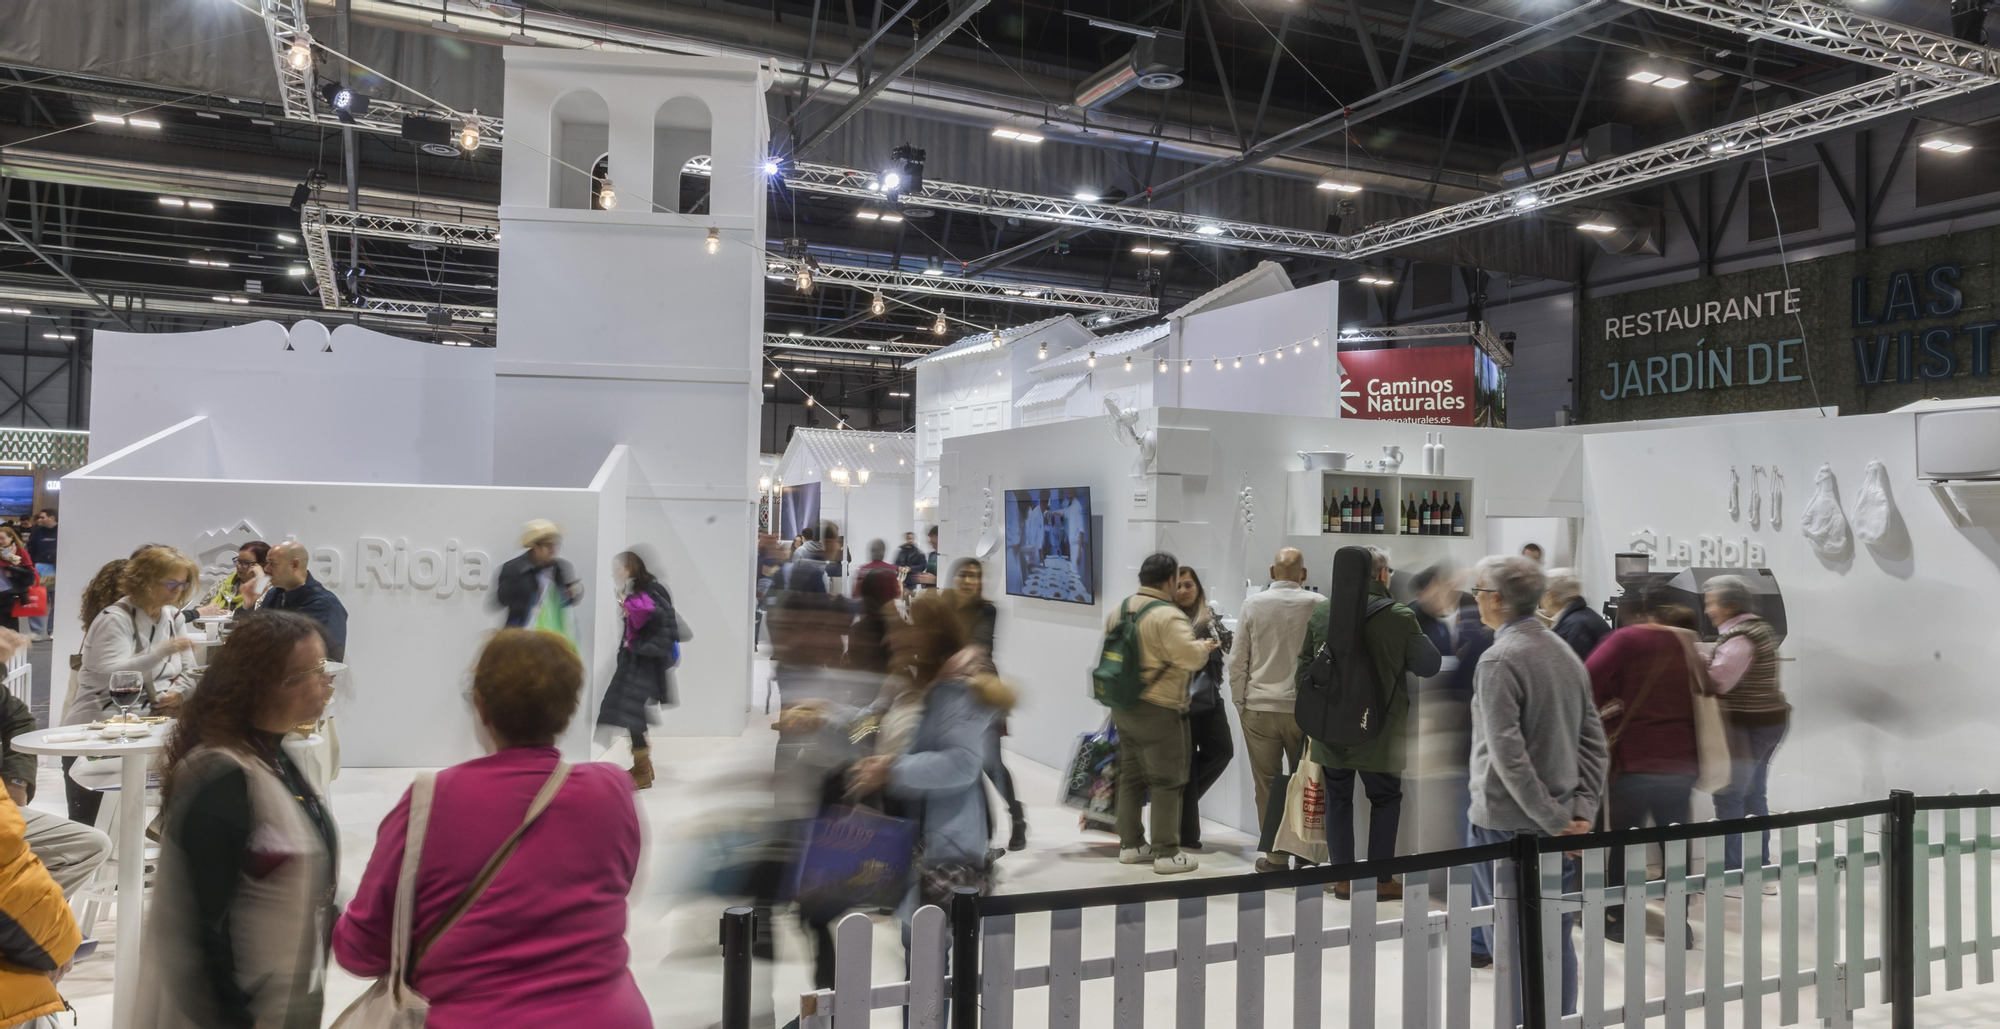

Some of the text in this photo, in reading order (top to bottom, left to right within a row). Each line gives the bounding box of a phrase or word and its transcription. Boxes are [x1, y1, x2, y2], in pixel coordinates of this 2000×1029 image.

[1605, 287, 1801, 341] RESTAURANTE
[1852, 262, 1963, 328] LAS
[1600, 338, 1804, 401] JARDÍN DE
[1853, 319, 2000, 386] VIST
[1367, 377, 1454, 396] Caminos
[1367, 392, 1465, 413] Naturales
[355, 536, 491, 600] Rioja
[1665, 534, 1766, 568] La Rioja
